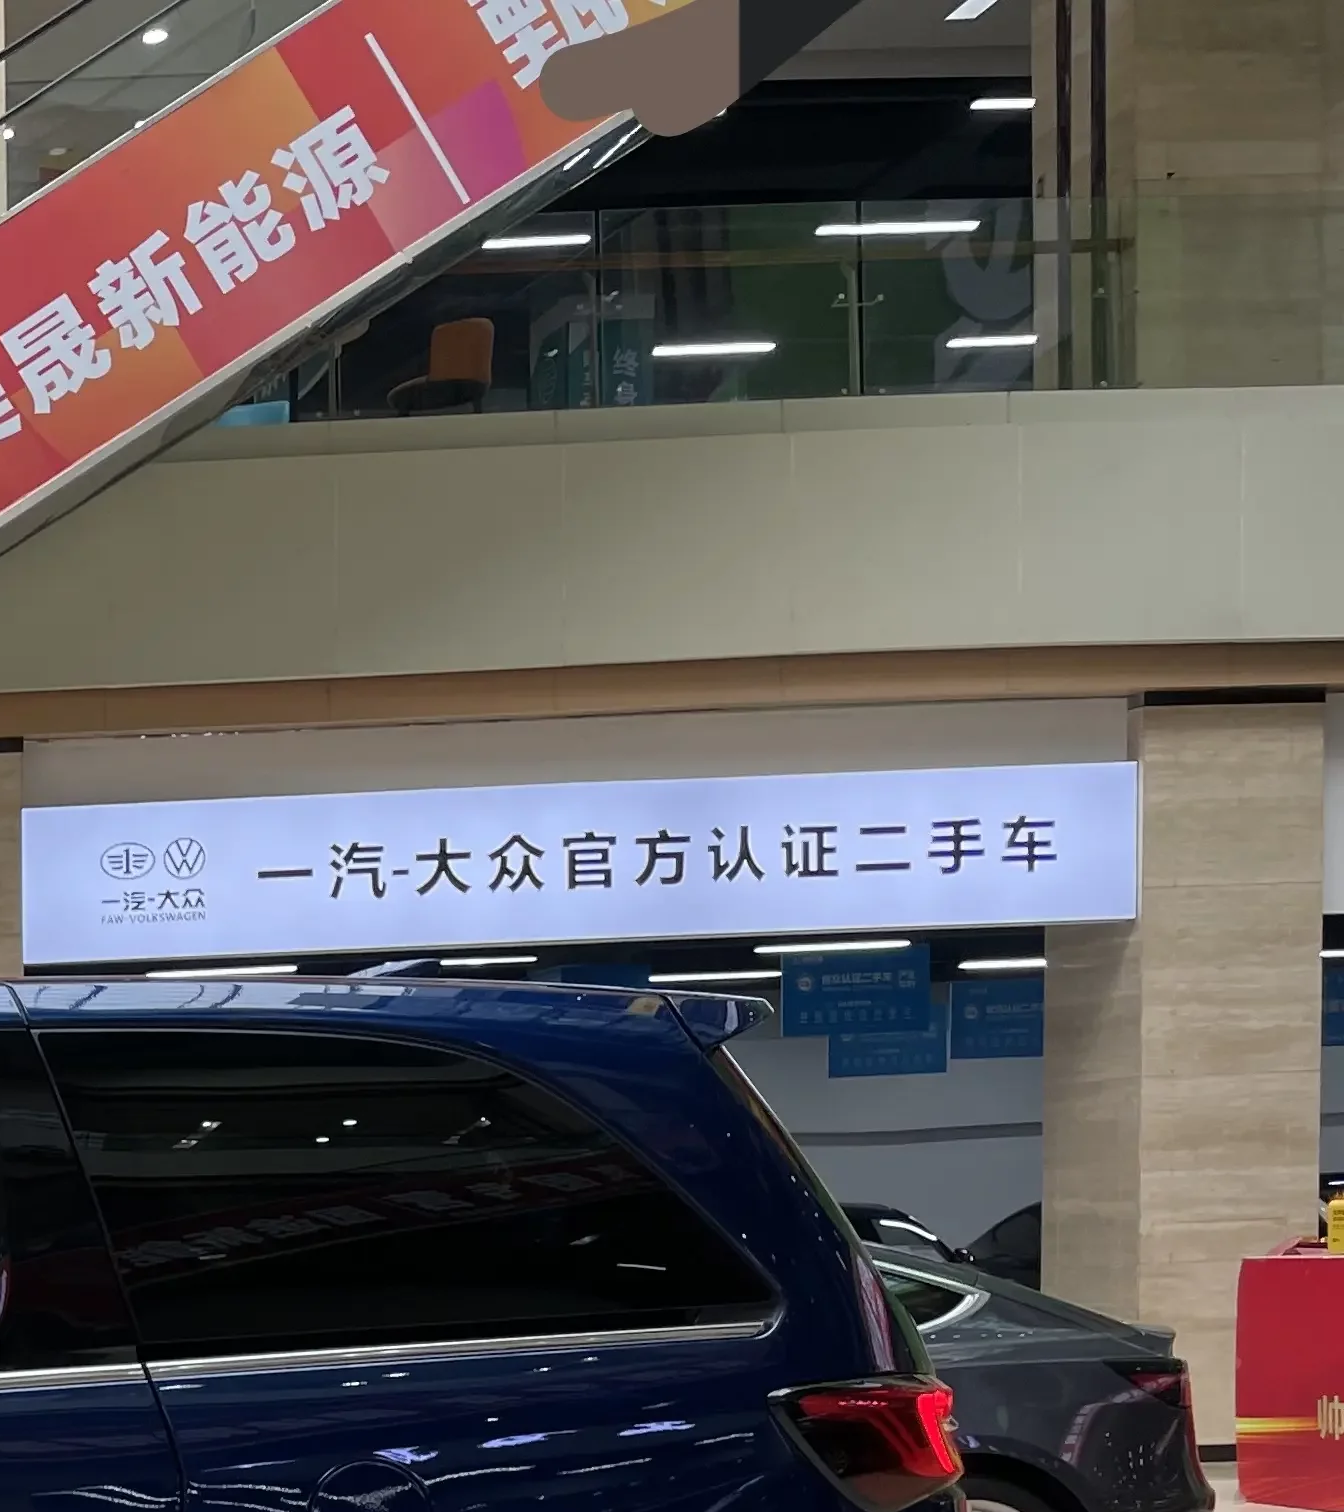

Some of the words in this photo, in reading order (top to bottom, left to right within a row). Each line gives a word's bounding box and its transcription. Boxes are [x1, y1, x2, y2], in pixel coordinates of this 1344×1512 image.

[256, 814, 1060, 900] 一汽-大众官方认证二手车
[101, 887, 206, 912] 一汽-大众
